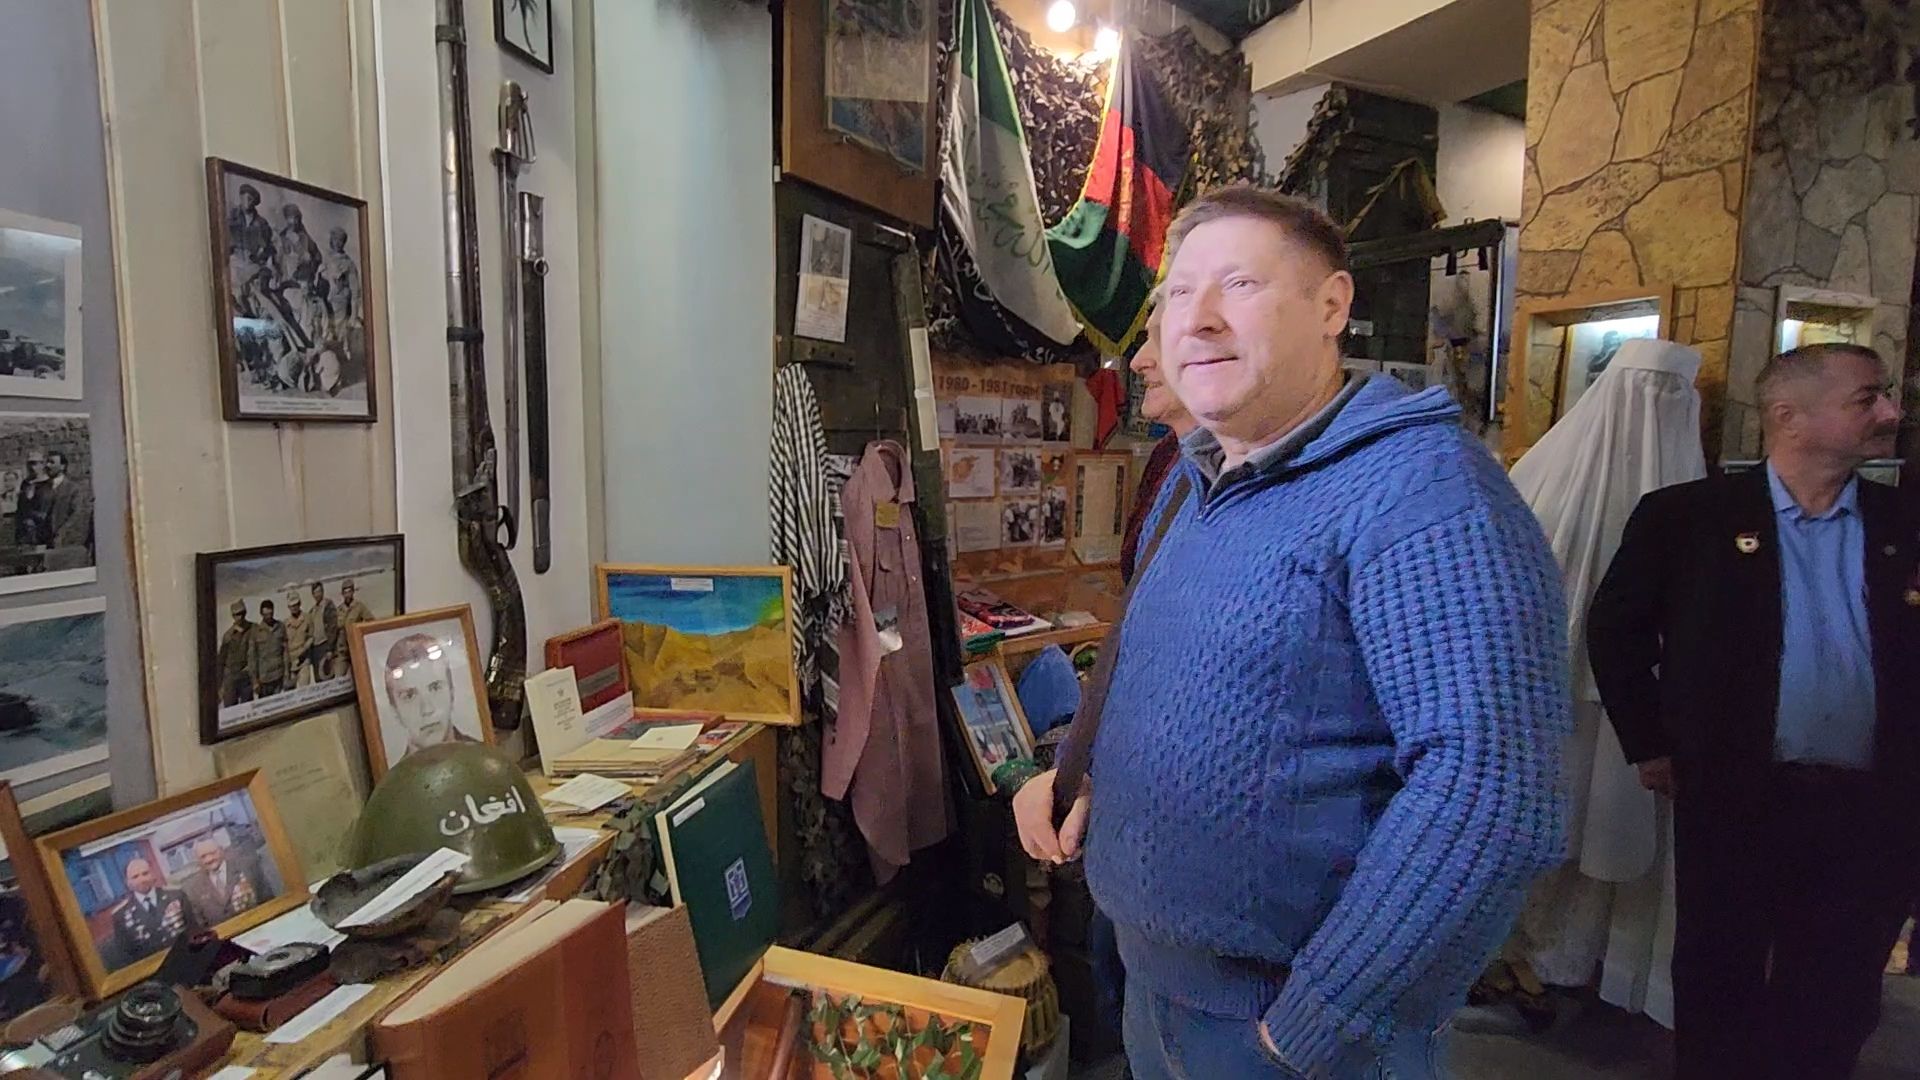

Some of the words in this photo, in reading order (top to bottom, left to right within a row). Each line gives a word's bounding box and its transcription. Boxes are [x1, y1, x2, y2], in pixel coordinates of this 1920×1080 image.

[938, 375, 970, 392] 1980
[980, 378, 1008, 394] 1981
[440, 785, 526, 836] افغان
